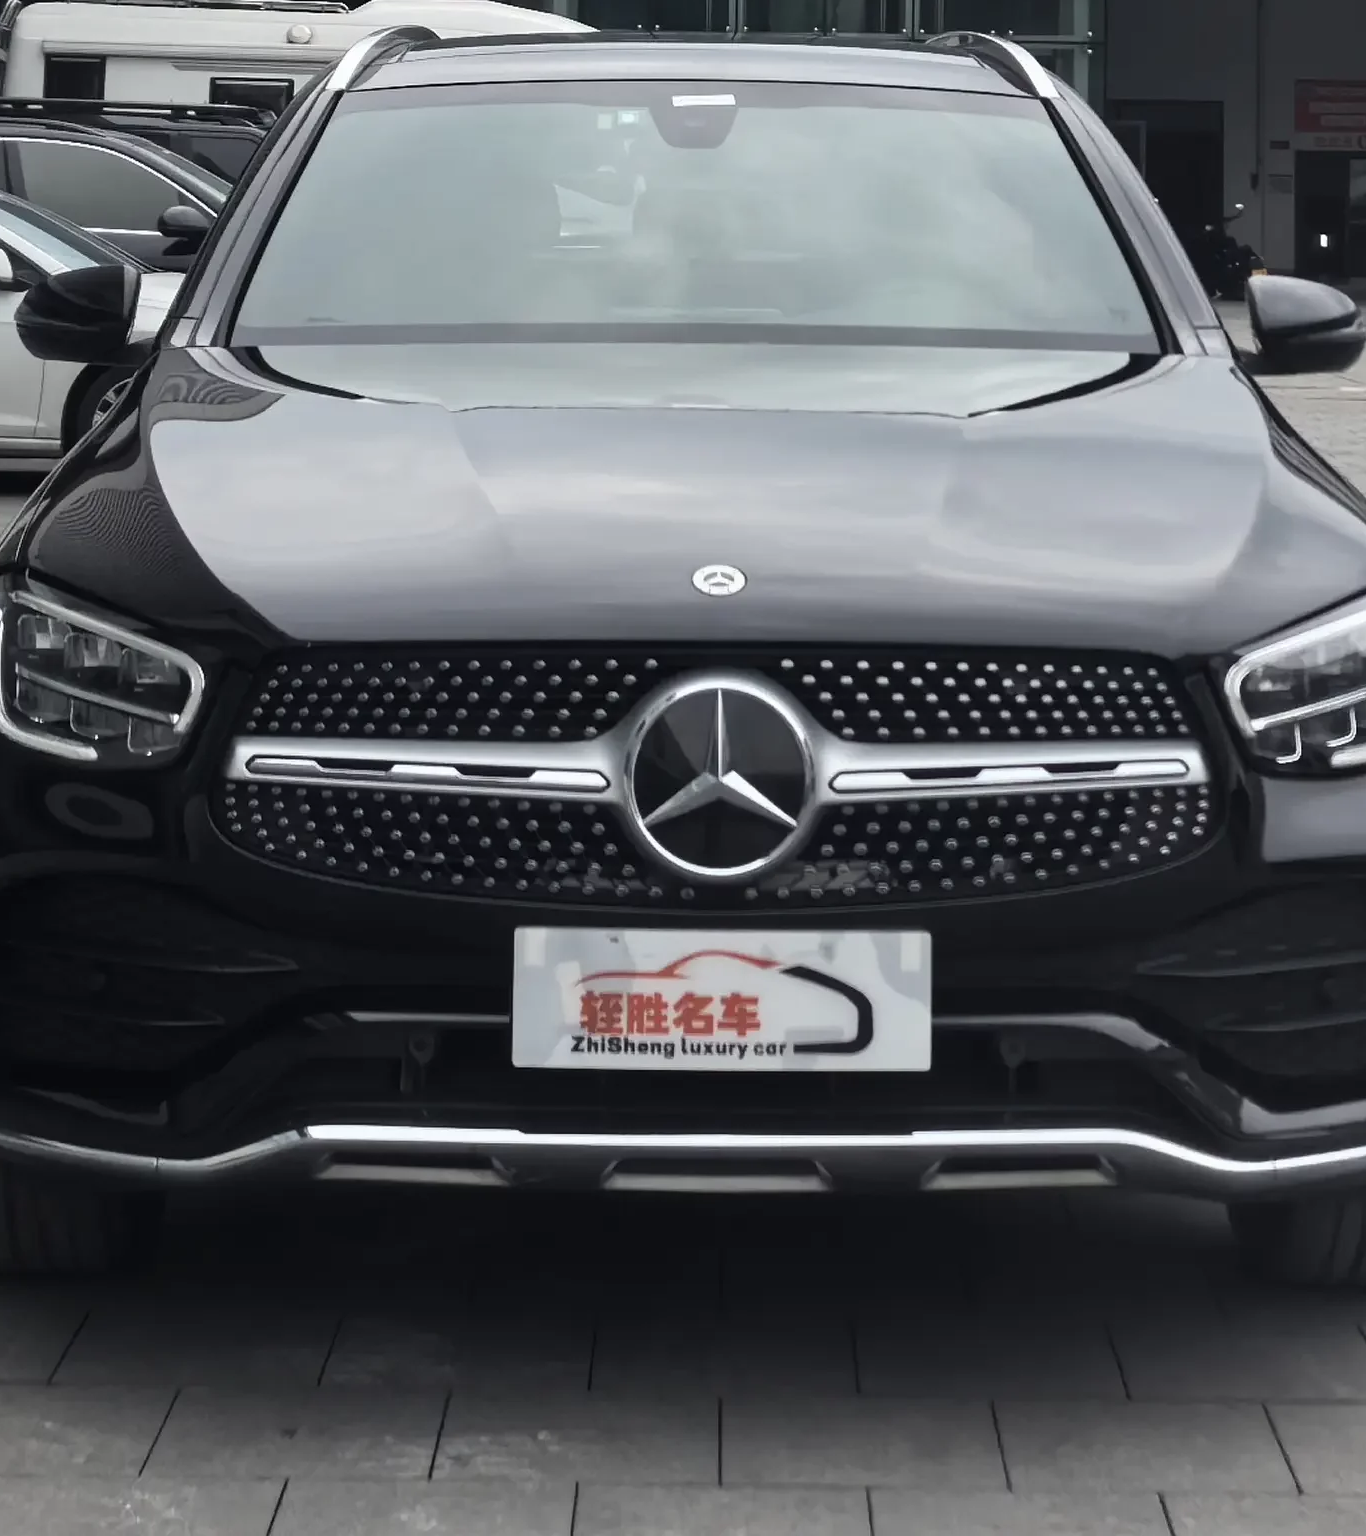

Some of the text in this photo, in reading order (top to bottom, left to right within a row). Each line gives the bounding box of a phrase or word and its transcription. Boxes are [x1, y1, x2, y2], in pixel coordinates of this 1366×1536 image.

[570, 1036, 787, 1060] ZhiSheng luxury car
